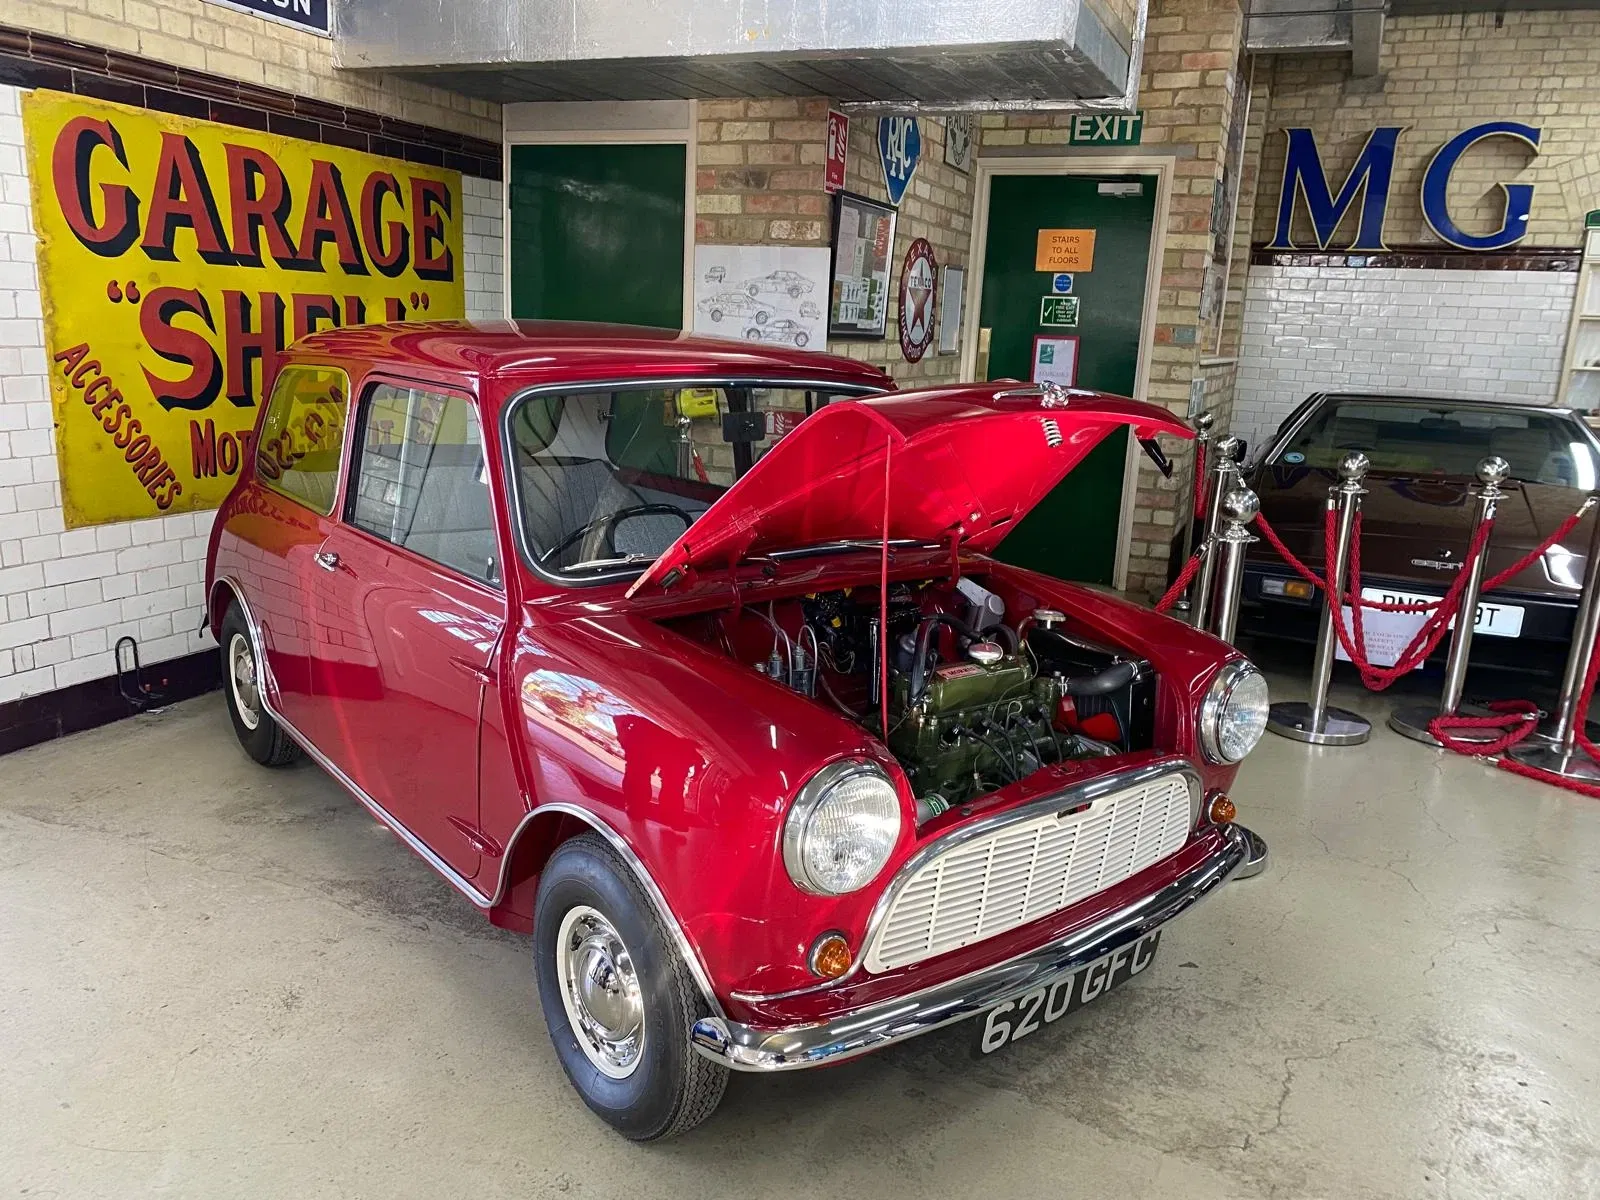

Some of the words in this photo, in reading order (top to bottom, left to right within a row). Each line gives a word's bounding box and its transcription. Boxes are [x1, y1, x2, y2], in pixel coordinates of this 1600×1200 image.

[1074, 115, 1141, 141] EXIT
[52, 115, 454, 282] GARAGE
[1263, 121, 1544, 252] MG
[1051, 235, 1080, 244] STAIRS
[1051, 246, 1063, 254] TO
[1064, 246, 1079, 254] ALL
[905, 241, 938, 280] TEXACO
[1048, 256, 1080, 264] FLOORS
[54, 341, 182, 511] ACCESSORIES
[1411, 559, 1464, 570] espri
[981, 975, 1075, 1054] 620
[1080, 935, 1157, 1004] GFC
